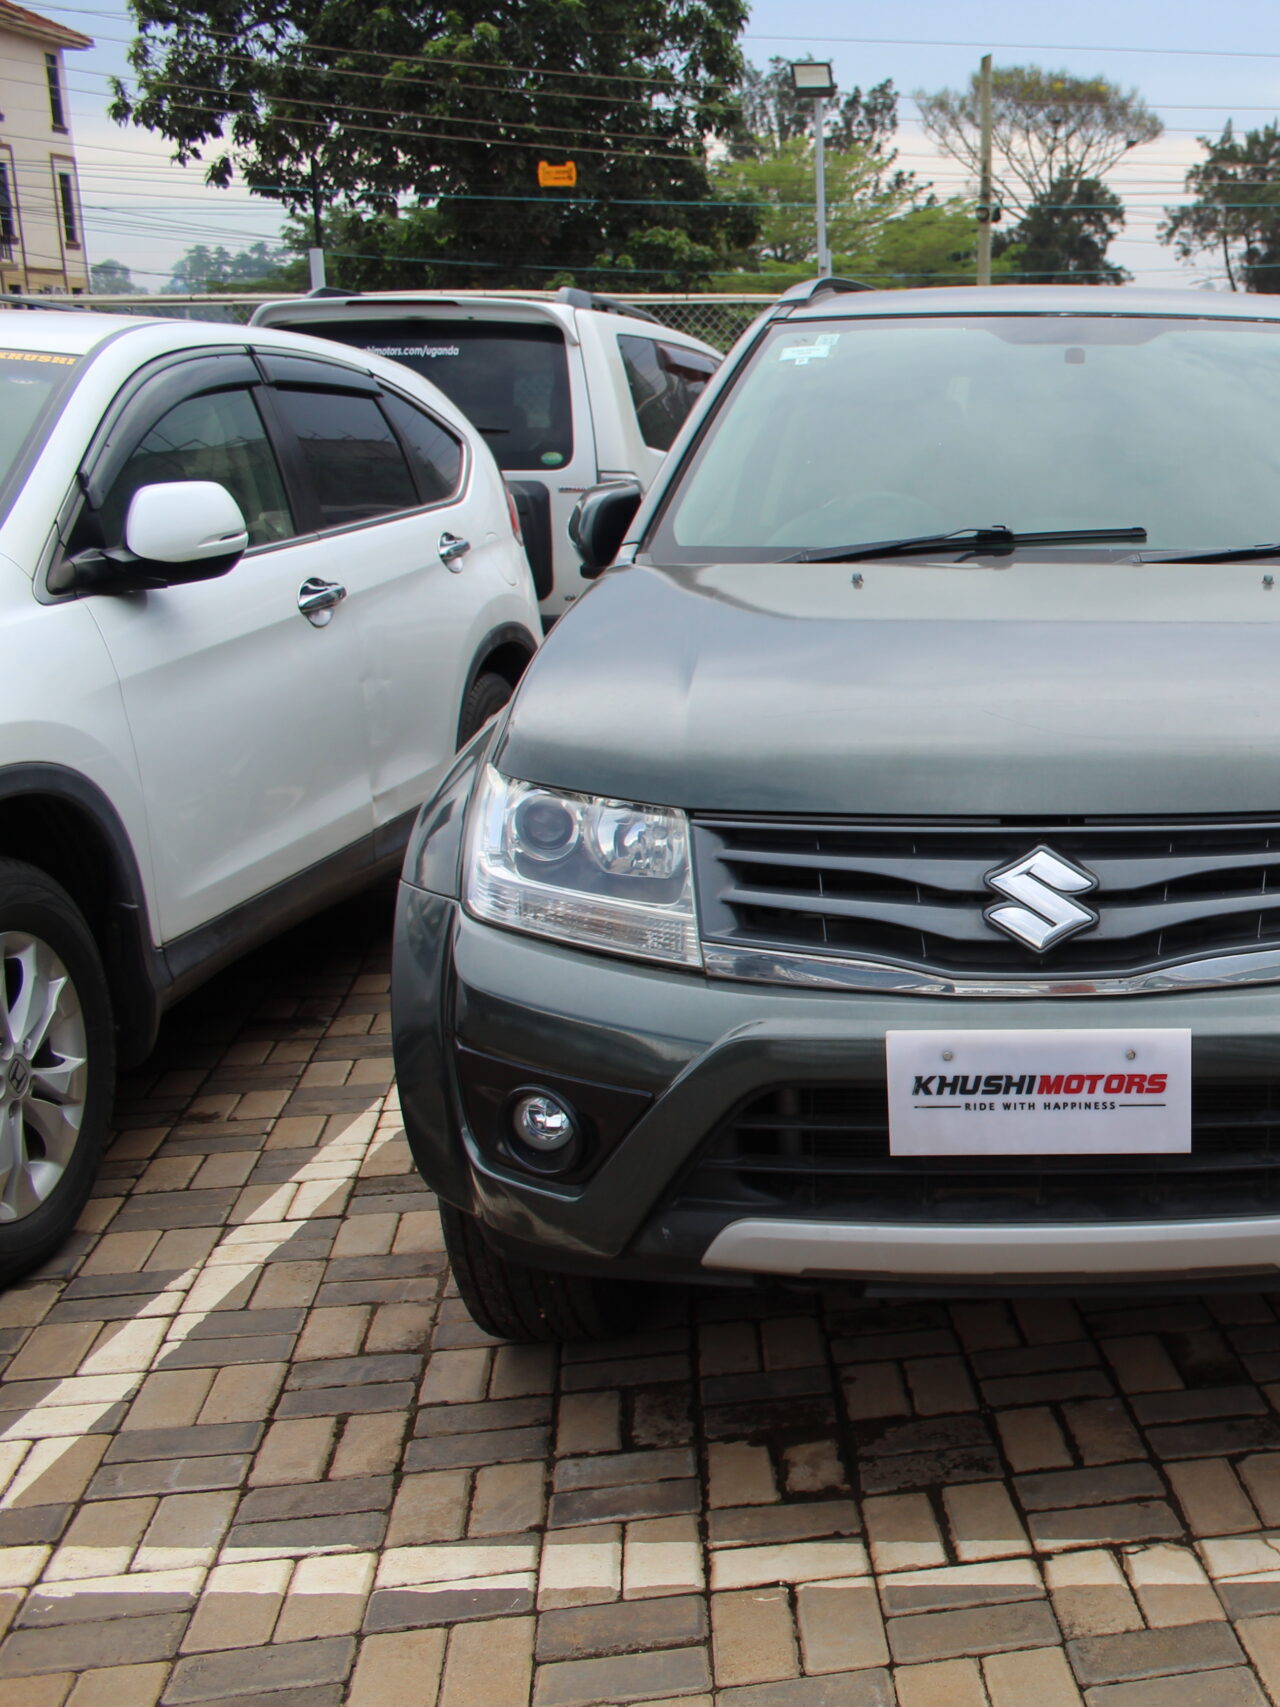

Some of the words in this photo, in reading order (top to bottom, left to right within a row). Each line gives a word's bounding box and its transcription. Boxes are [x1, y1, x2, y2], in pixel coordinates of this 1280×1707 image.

[366, 345, 460, 358] himotors.com/uganda
[911, 1073, 1168, 1096] KHUSHIMOTORS
[964, 1102, 996, 1112] RIDE
[1002, 1101, 1036, 1112] WITH
[1043, 1101, 1117, 1111] HAPPINESS
